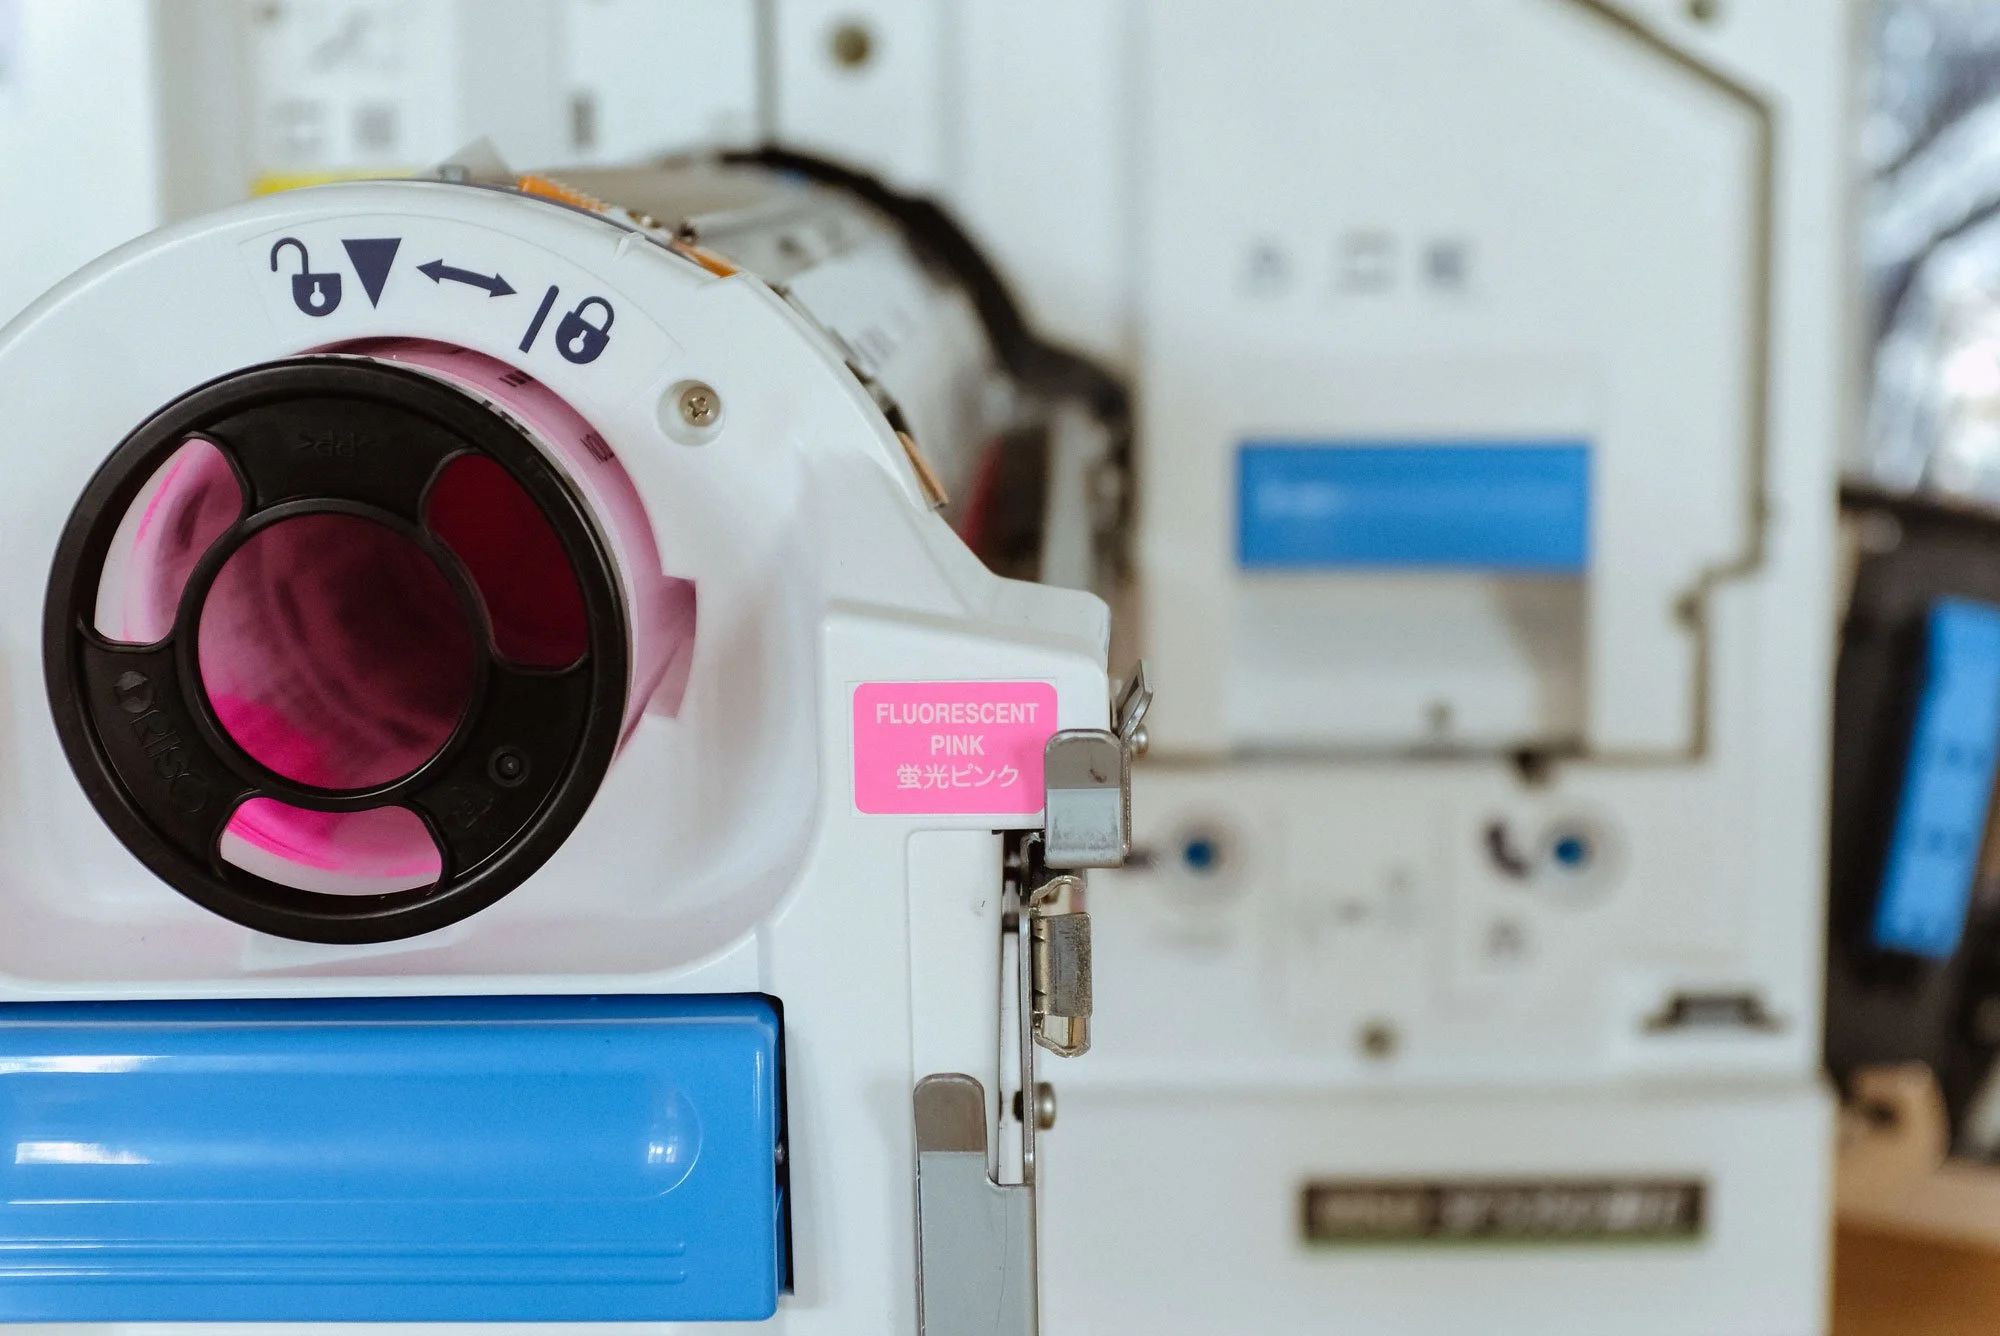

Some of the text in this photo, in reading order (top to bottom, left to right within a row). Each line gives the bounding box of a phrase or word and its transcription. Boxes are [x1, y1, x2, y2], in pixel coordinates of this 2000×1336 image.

[875, 702, 1039, 725] FLUORESCENT
[930, 734, 985, 756] PINK
[896, 763, 1020, 789] 蛍光ピンク
